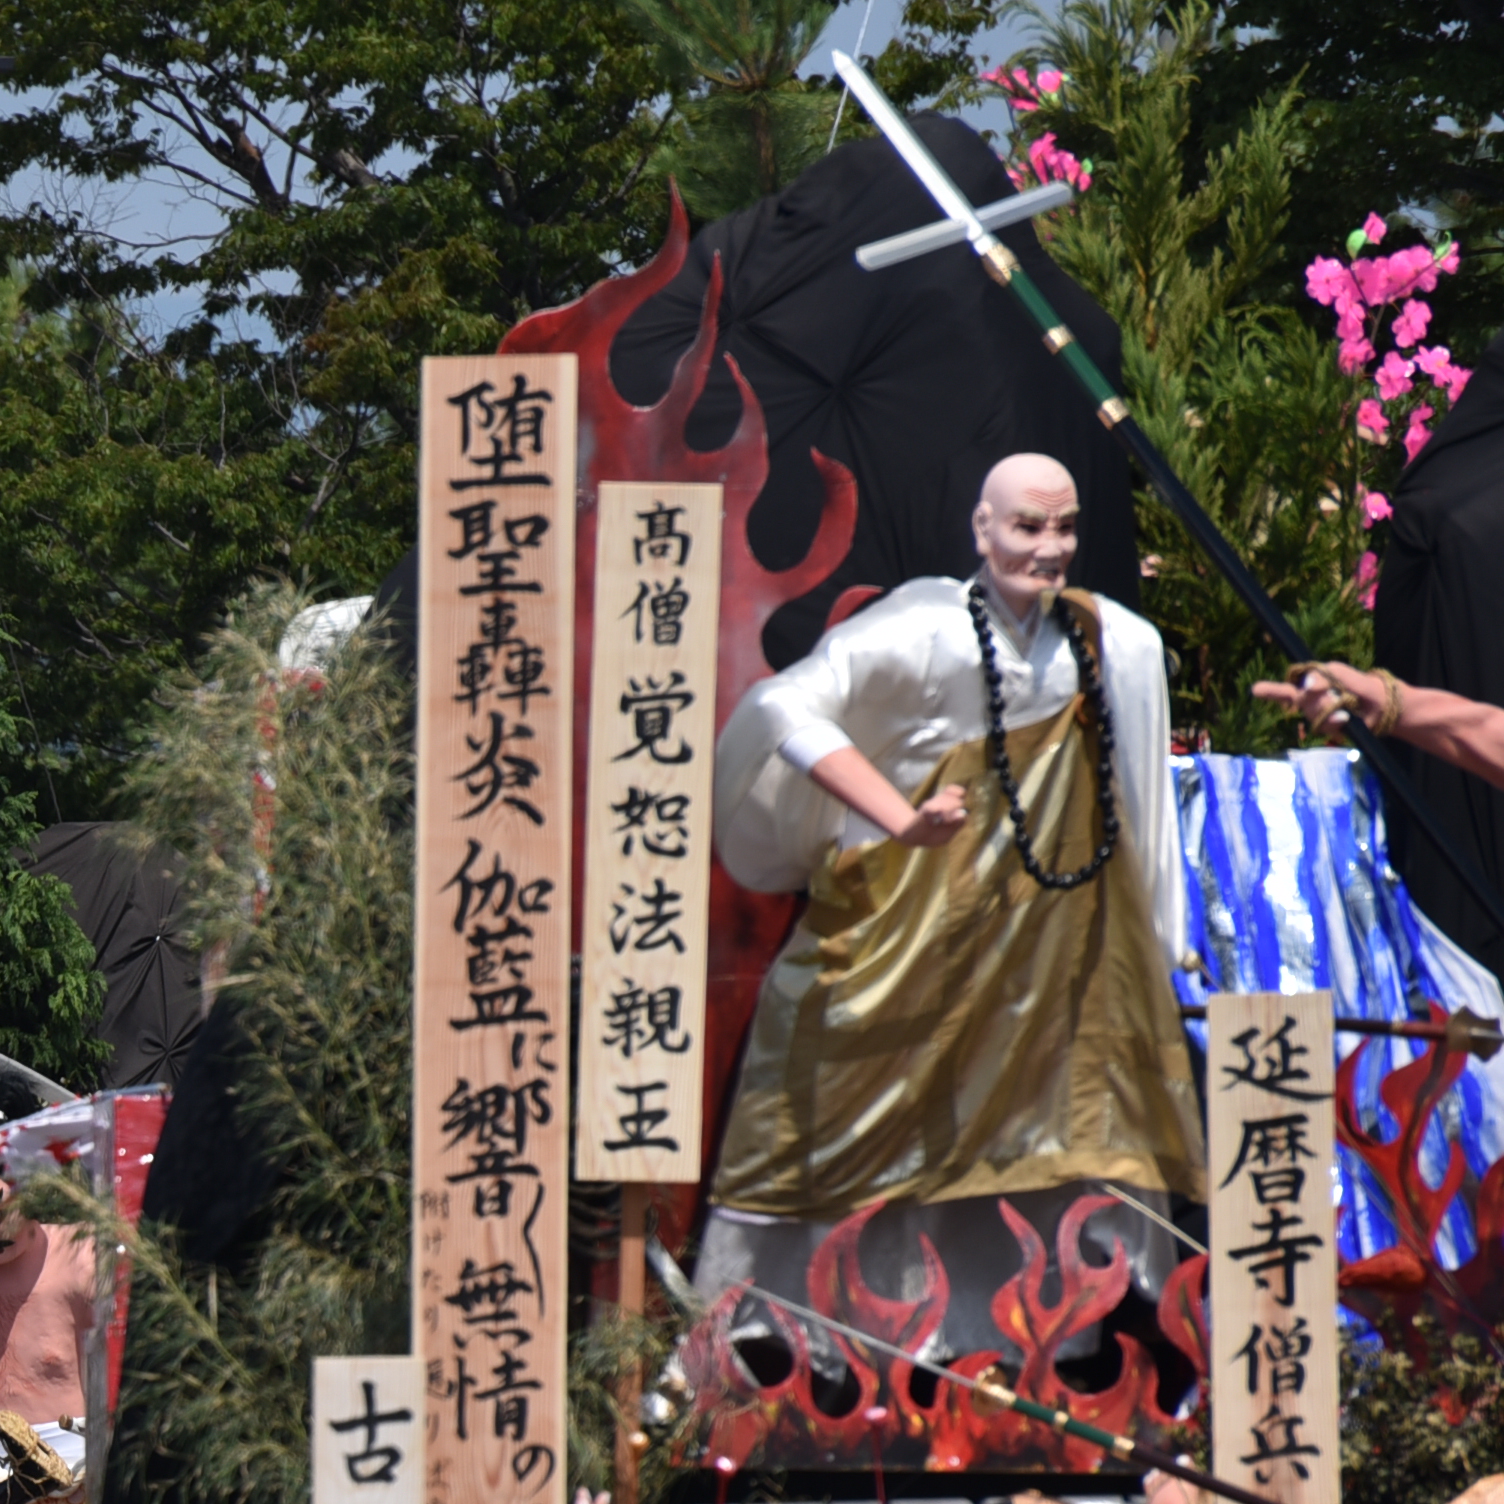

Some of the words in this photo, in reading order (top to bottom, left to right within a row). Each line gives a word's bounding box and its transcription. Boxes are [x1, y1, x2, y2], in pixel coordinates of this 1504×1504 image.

[1219, 1017, 1333, 1486] 延暦寺僧兵
